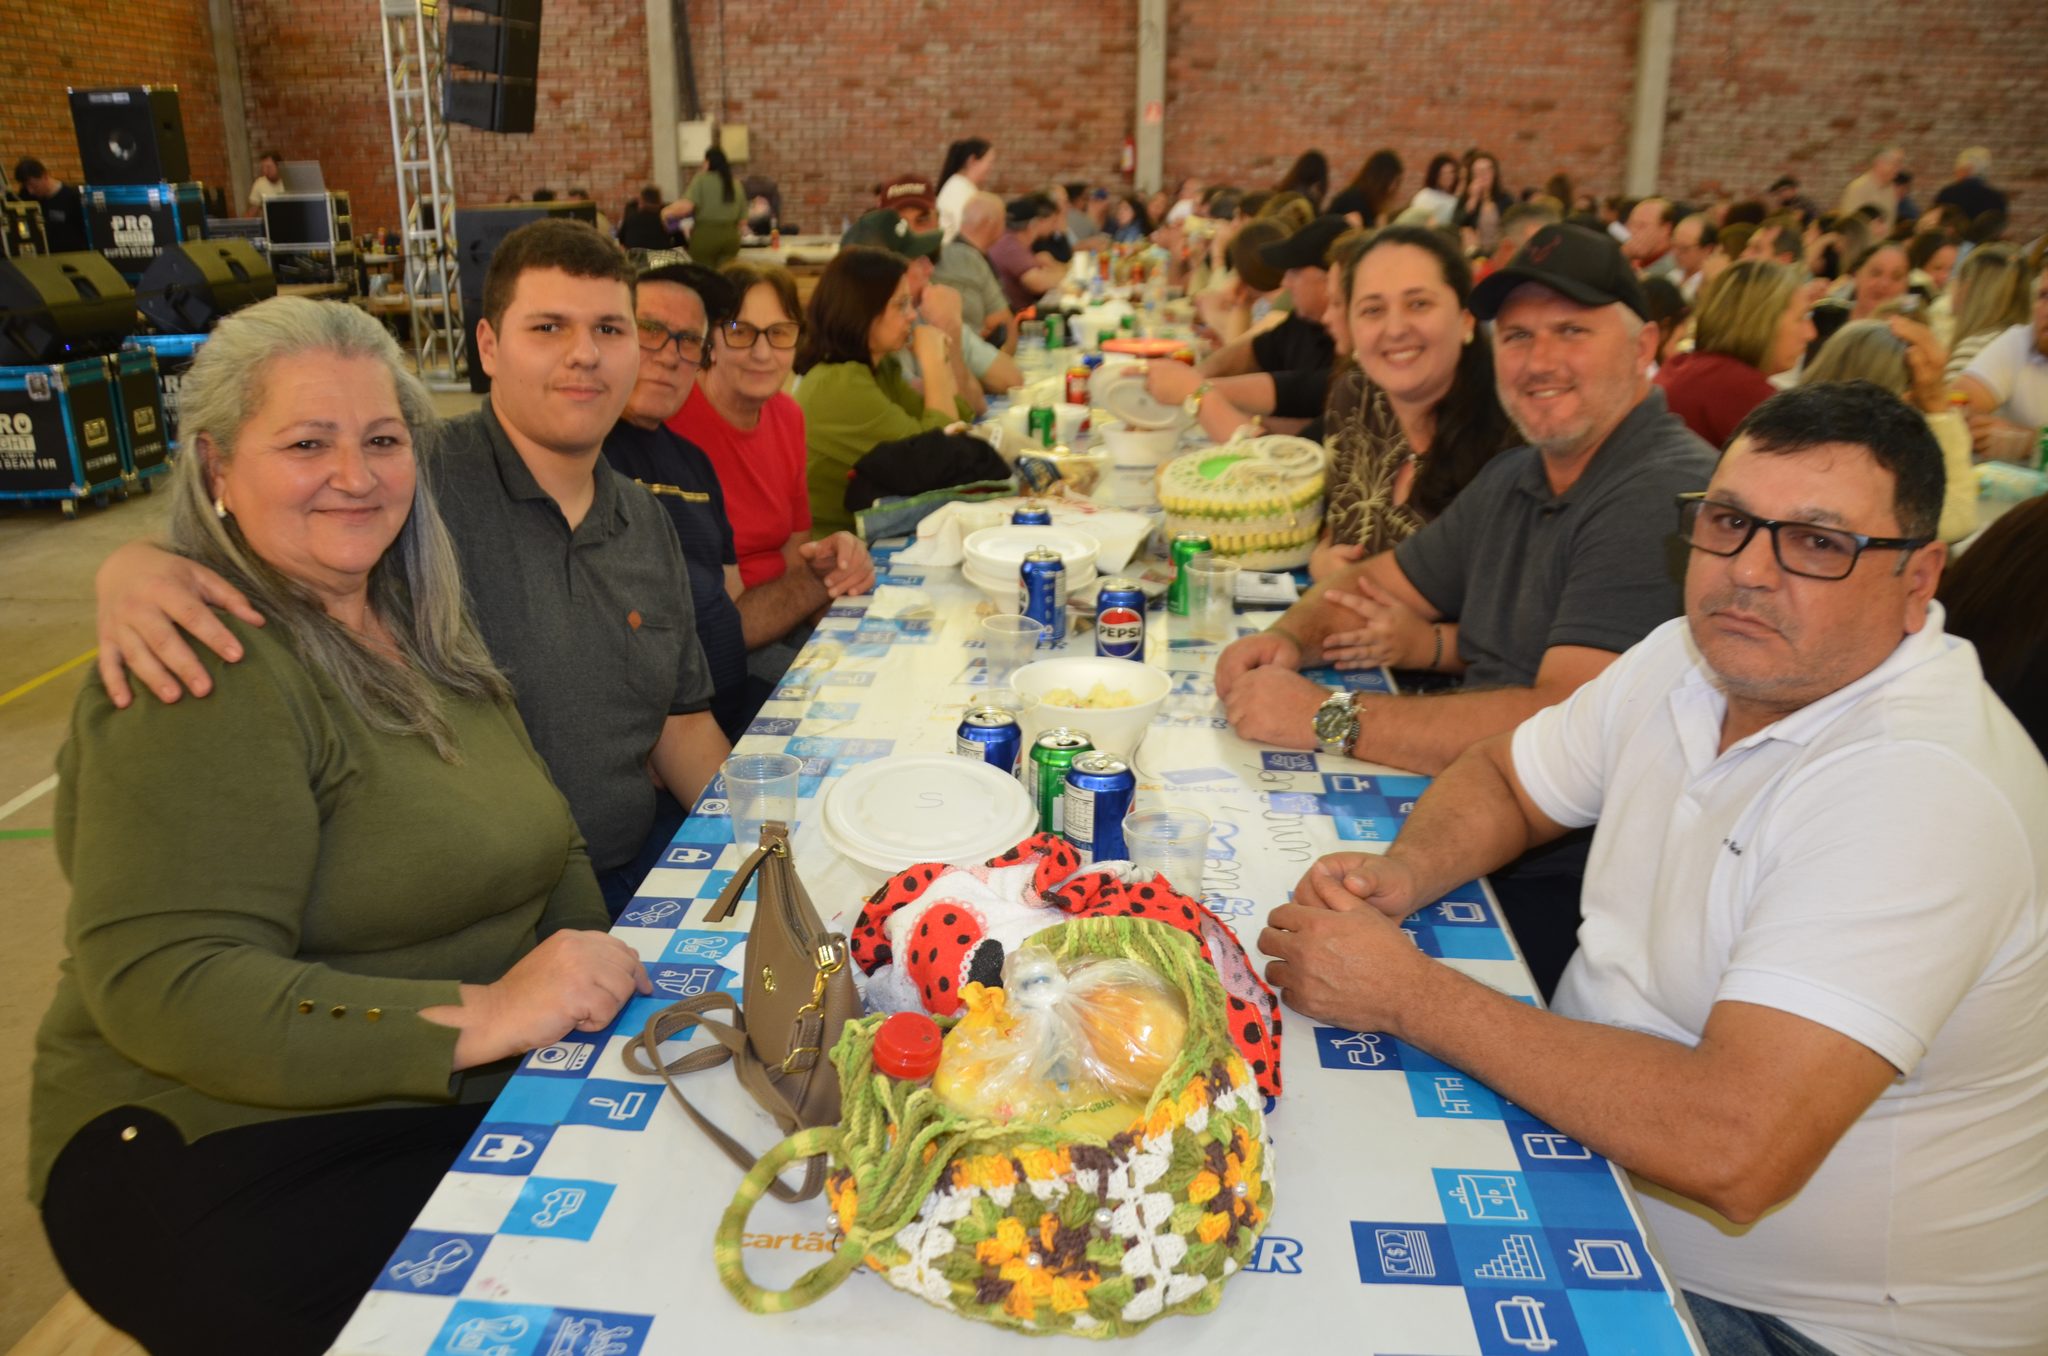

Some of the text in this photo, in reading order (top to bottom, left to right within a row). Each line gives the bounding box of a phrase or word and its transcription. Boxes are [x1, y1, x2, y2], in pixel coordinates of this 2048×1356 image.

[111, 214, 153, 231] PRO
[0, 412, 33, 434] RO
[1099, 624, 1142, 639] PEPSI
